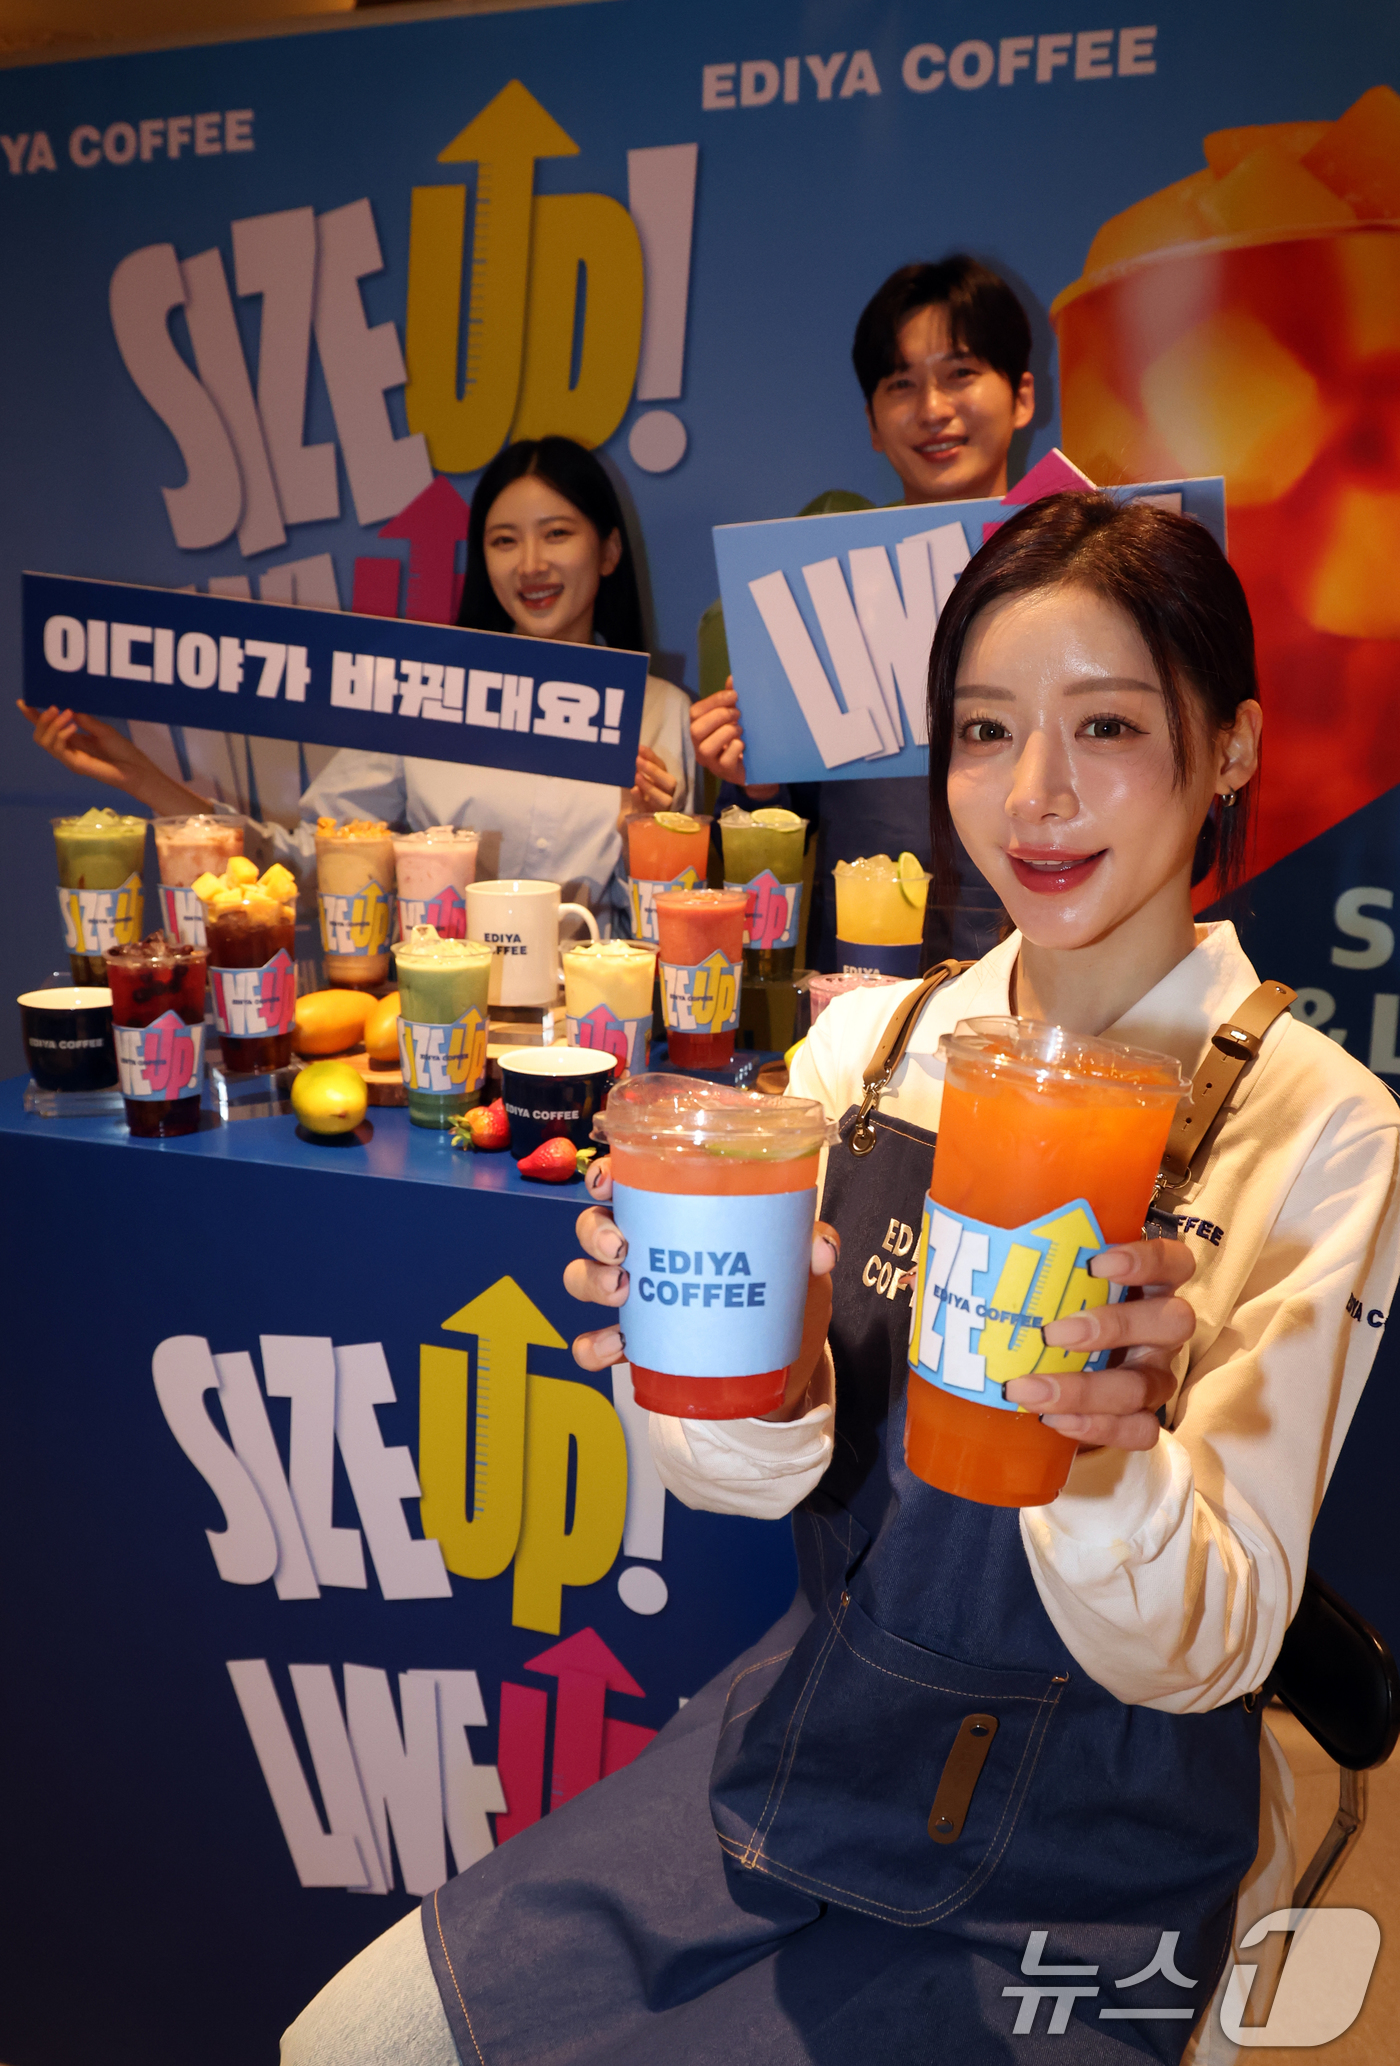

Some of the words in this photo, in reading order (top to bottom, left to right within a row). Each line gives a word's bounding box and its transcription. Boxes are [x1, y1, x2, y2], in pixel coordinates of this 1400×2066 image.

[702, 49, 882, 111] EDIYA
[902, 24, 1158, 92] COFFEE
[0, 131, 57, 175] YA
[69, 109, 254, 168] COFFEE
[110, 198, 433, 557] SIZE
[43, 614, 311, 702] 이디야가
[330, 651, 625, 744] 바뀐대요!
[484, 933, 521, 942] EDIYA
[492, 945, 528, 955] FFEE
[532, 1110, 580, 1120] COFFEE
[649, 1247, 752, 1276] EDIYA
[639, 1276, 767, 1308] COFFEE
[933, 1284, 971, 1313] EDIYA
[976, 1304, 1043, 1329] COFFEE
[152, 1335, 453, 1600] SIZE
